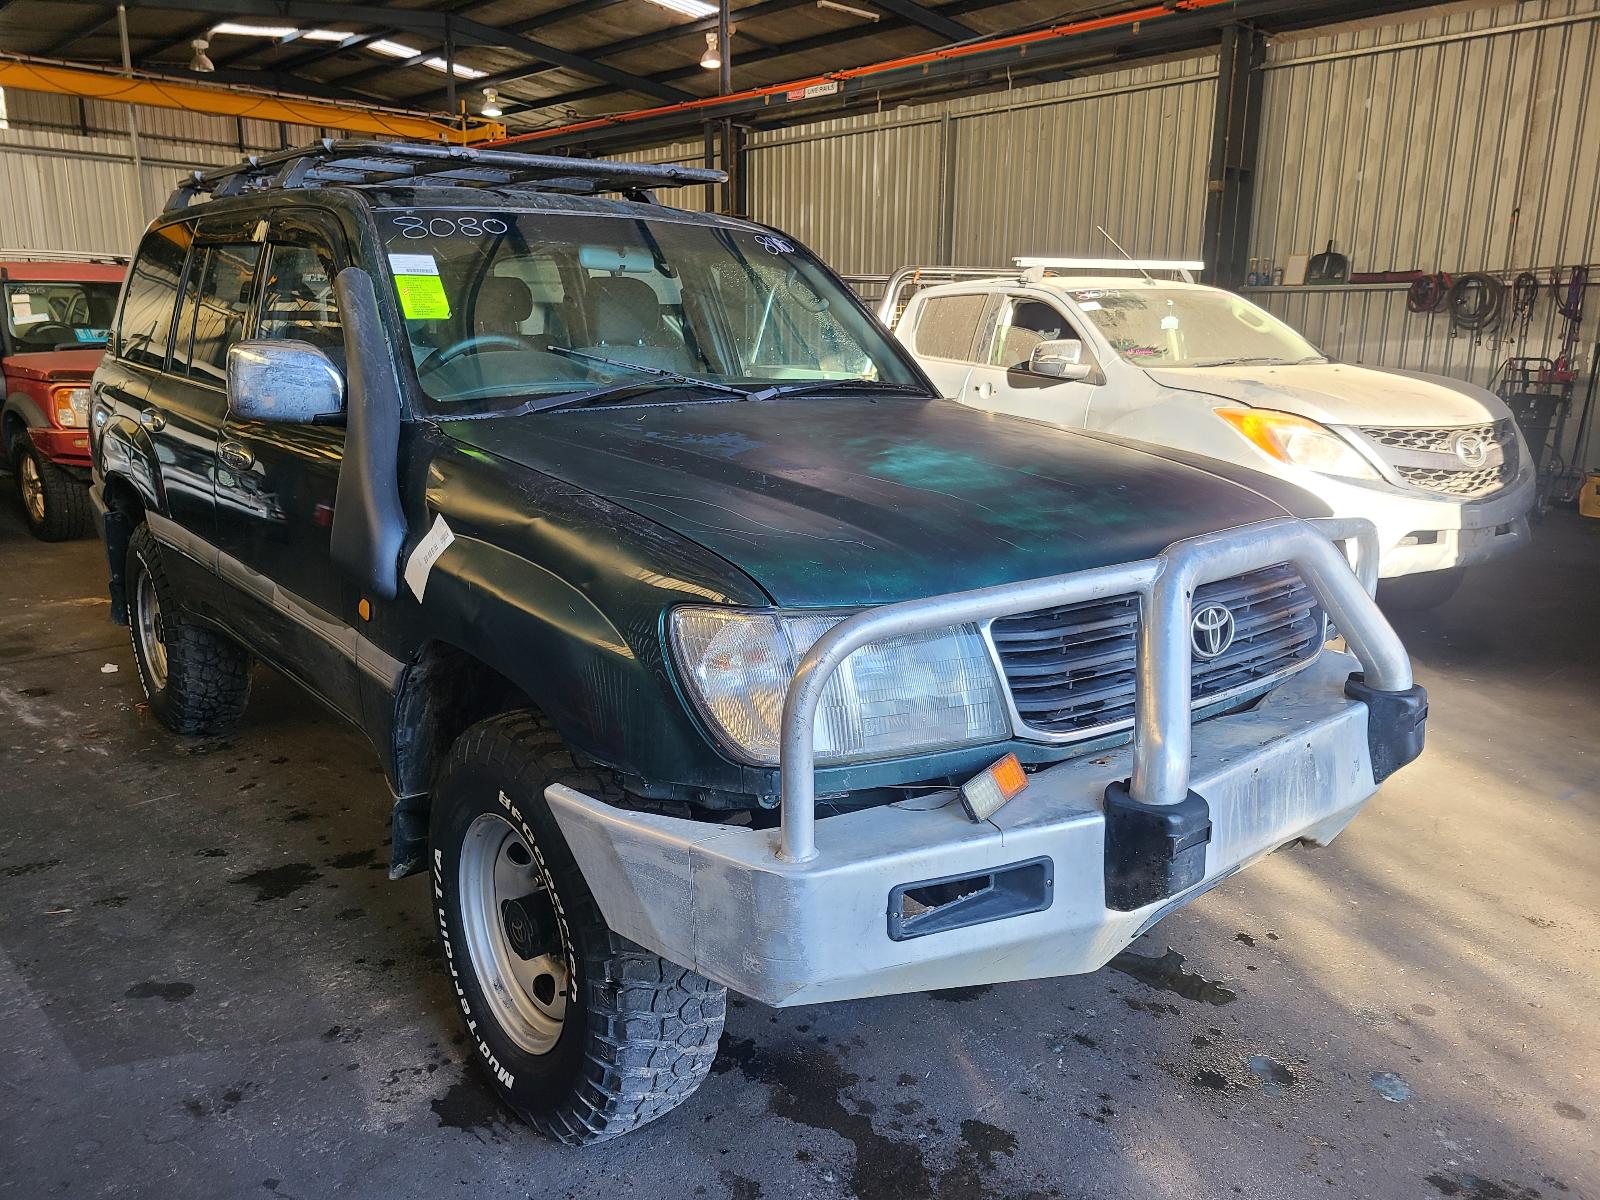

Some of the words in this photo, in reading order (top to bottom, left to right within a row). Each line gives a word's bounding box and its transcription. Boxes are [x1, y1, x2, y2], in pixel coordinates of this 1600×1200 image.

[393, 216, 508, 239] 8080
[434, 848, 443, 900] T/A
[499, 789, 578, 1003] BFGoodrich
[438, 907, 515, 1091] Mud-Terrain
